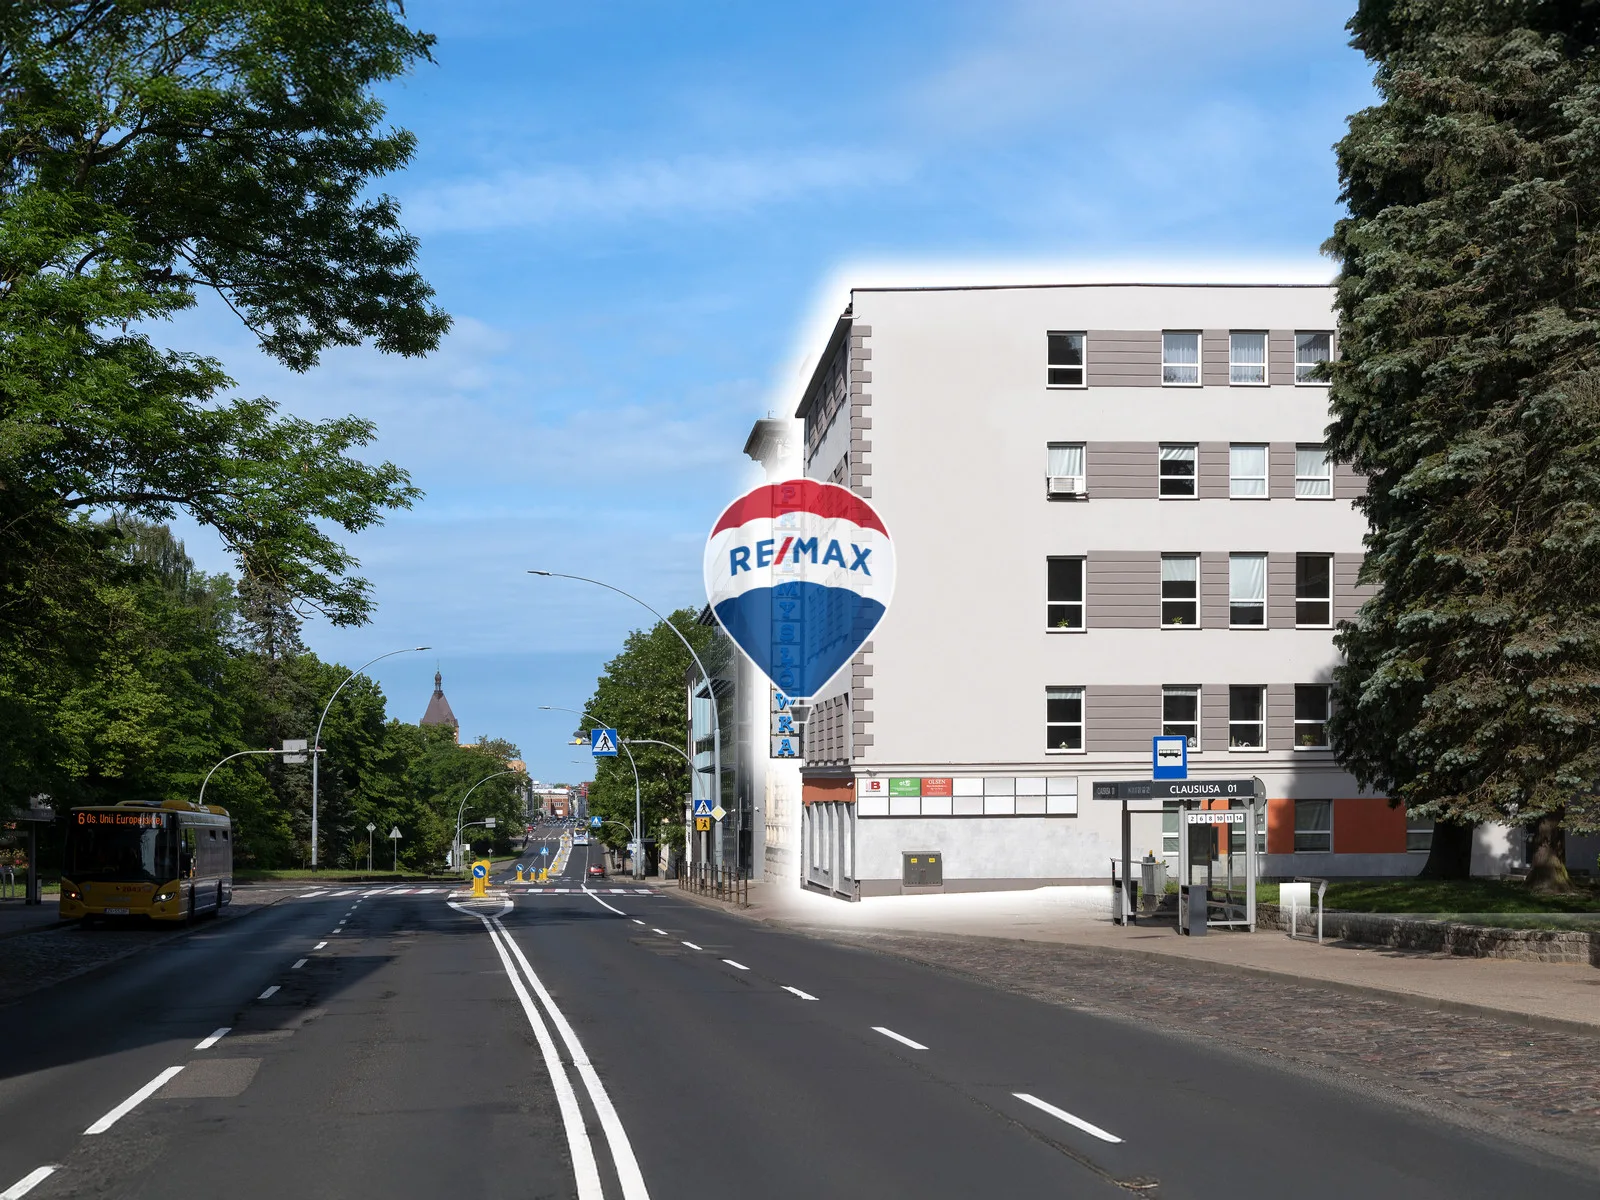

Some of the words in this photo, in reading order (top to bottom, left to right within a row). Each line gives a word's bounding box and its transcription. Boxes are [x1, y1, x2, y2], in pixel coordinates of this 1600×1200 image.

[1169, 784, 1221, 794] CLAUSIUSA
[1227, 784, 1237, 793] 01
[78, 812, 86, 825] 6
[99, 813, 114, 824] Unii
[116, 814, 163, 826] Europejskiej
